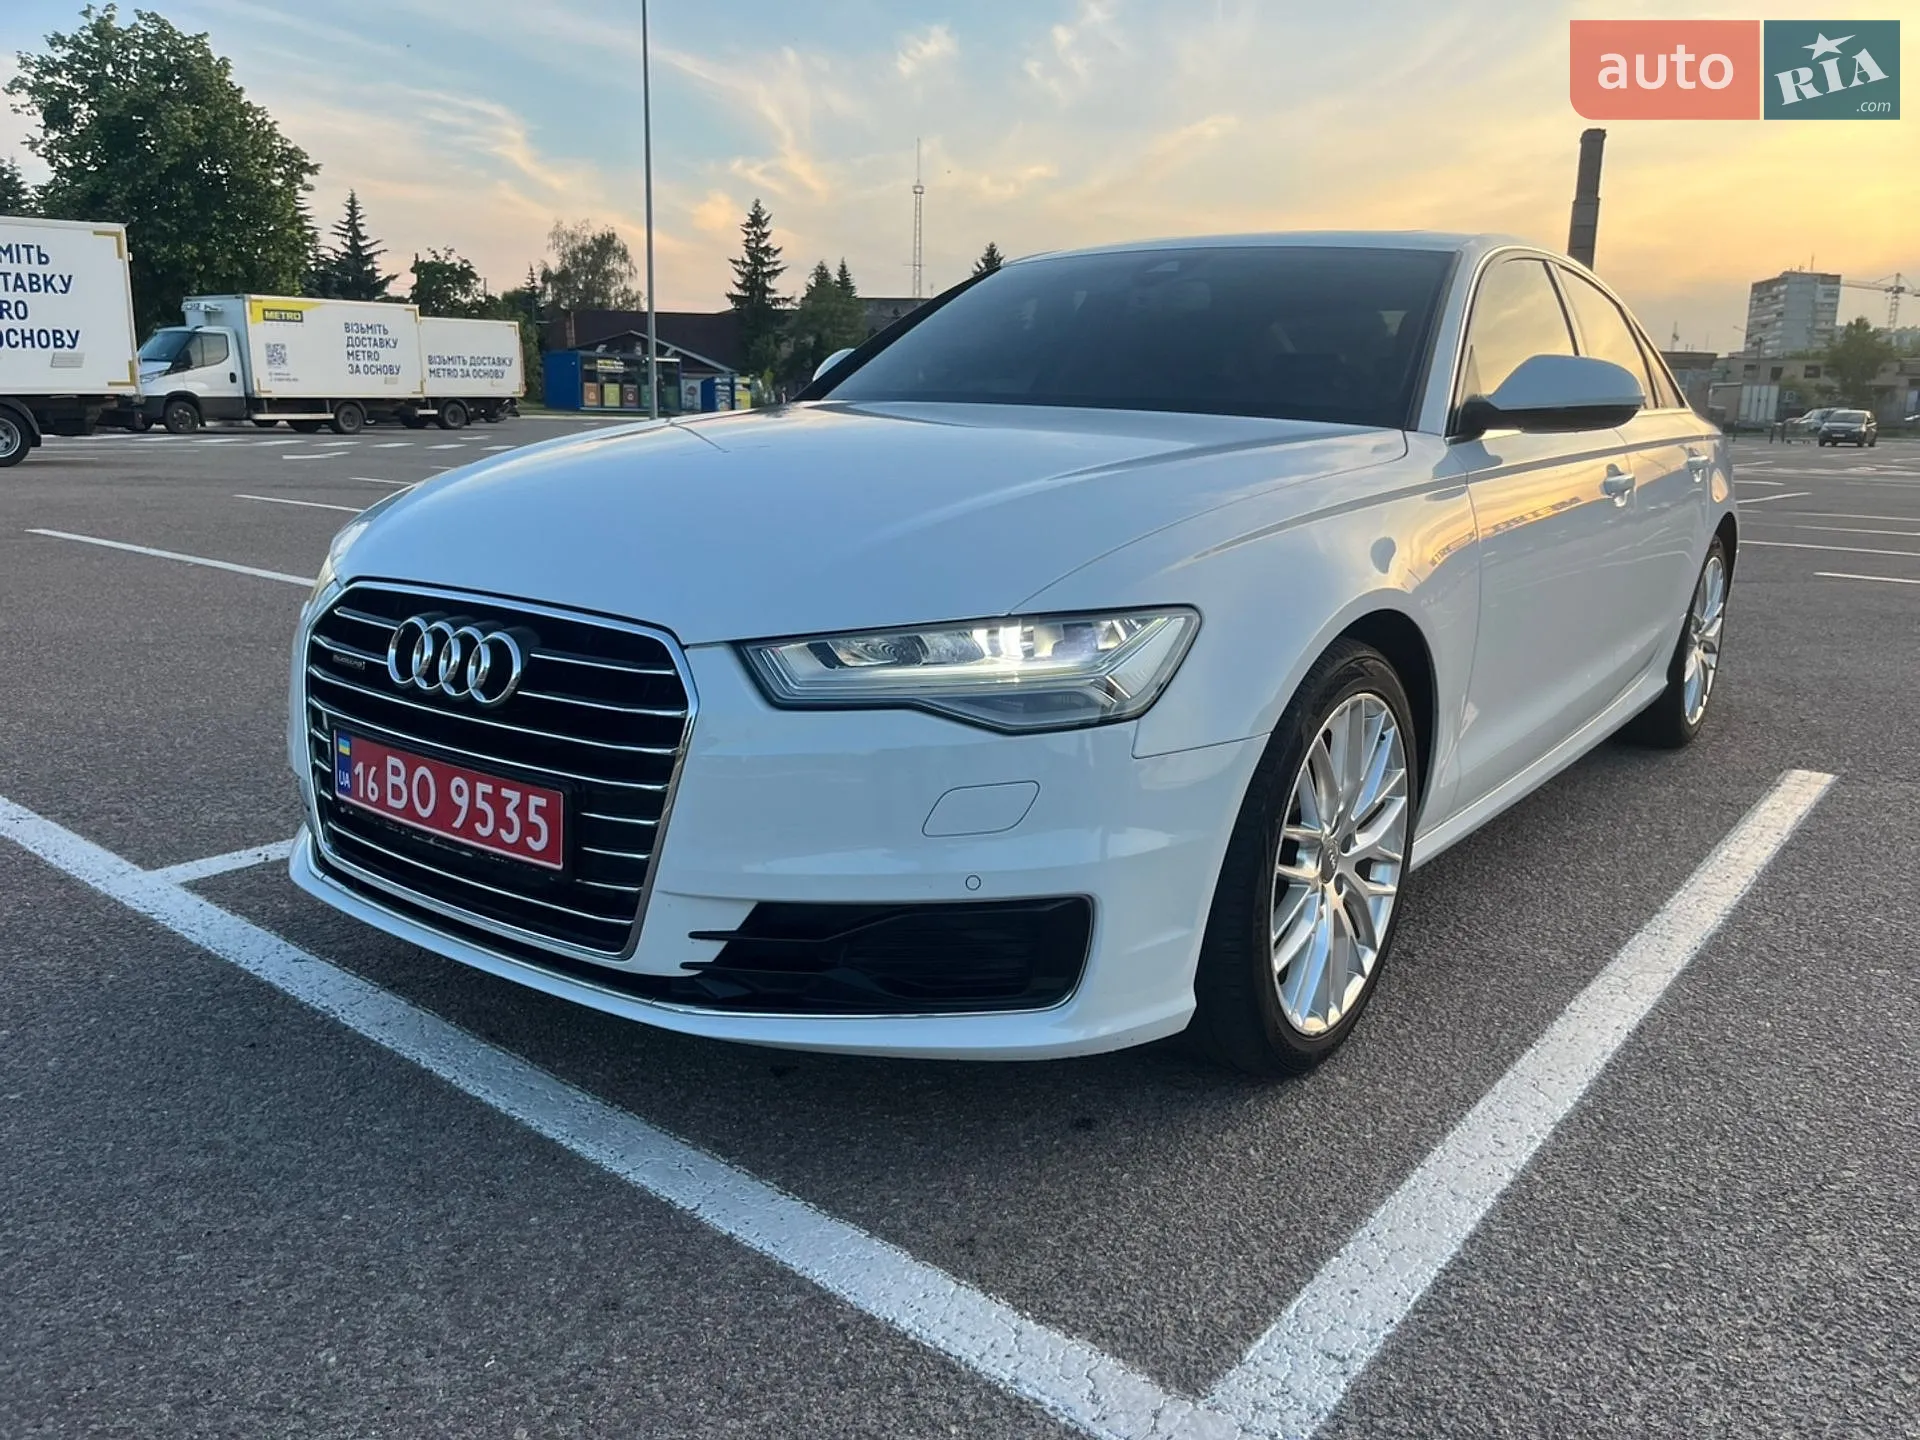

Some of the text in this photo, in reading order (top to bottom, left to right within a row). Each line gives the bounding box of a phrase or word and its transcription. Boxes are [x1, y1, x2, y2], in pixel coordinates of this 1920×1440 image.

[265, 310, 302, 321] METRO
[344, 322, 389, 335] ВІЗЬМІТЬ
[0, 328, 80, 349] СНОВУ
[346, 336, 398, 349] ДОСТАВКУ
[346, 350, 380, 361] METRO
[348, 363, 401, 375] ЗА ОСНОВУ
[338, 769, 351, 789] UA
[354, 761, 380, 802] 16
[449, 776, 549, 853] 9535
